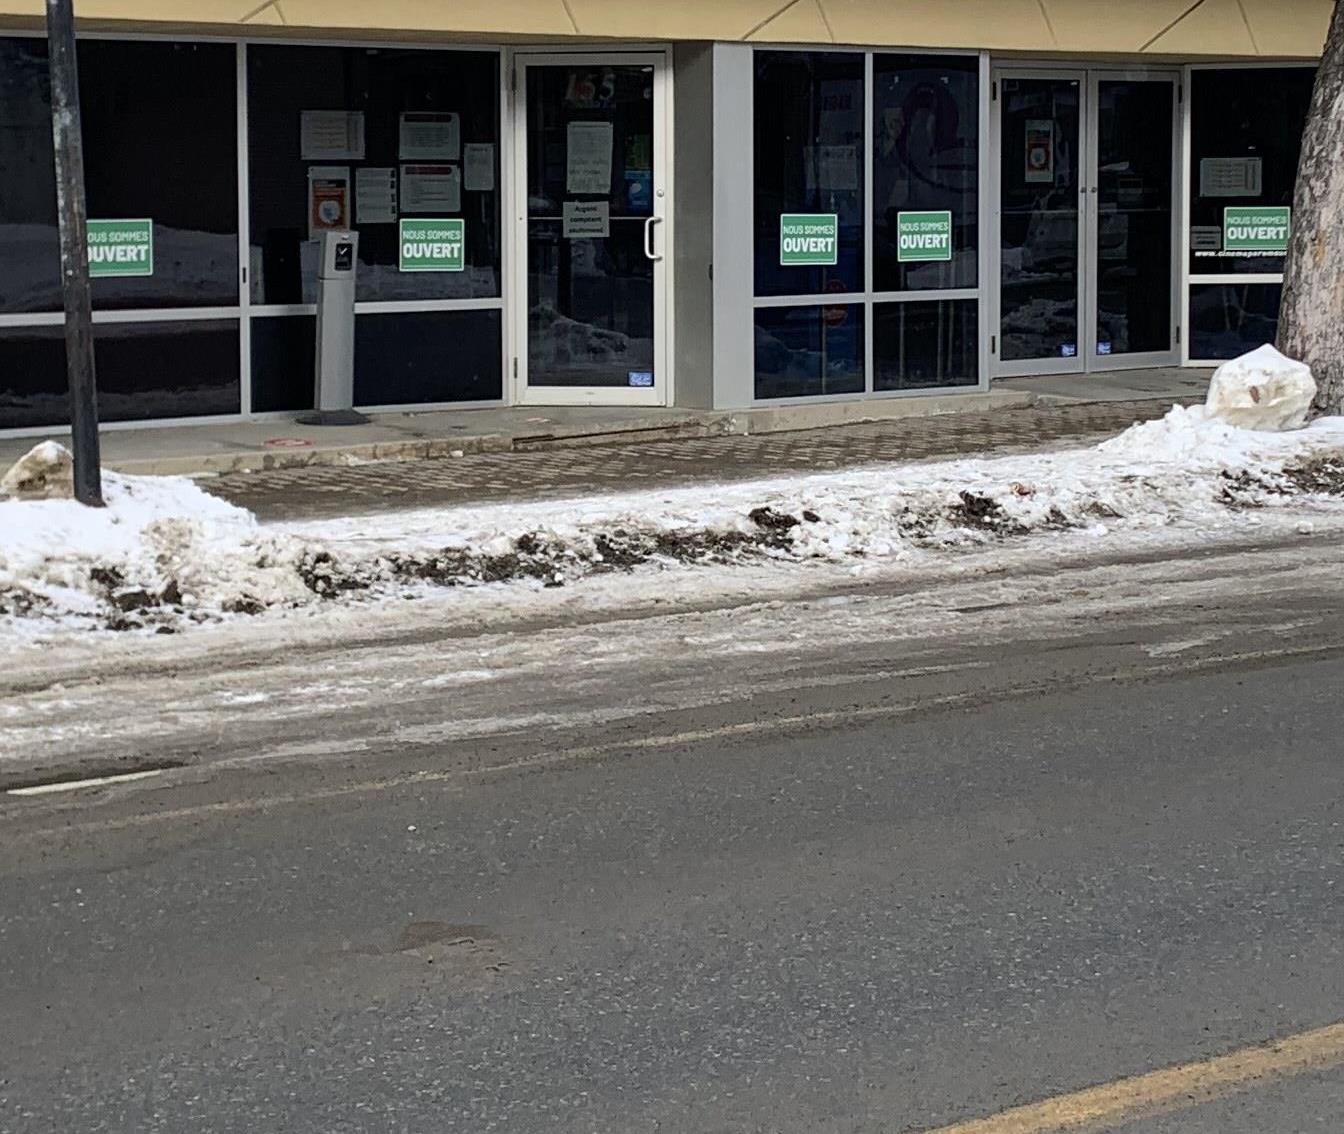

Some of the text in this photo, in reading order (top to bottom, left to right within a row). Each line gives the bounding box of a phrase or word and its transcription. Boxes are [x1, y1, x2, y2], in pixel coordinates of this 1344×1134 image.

[900, 221, 949, 232] NOUS SOMMES
[1227, 215, 1287, 225] NOUS SOMMES
[87, 230, 149, 243] OUS SOMMES
[402, 229, 461, 241] NOUS SOMMES
[783, 225, 834, 235] NOUS SOMMES
[1227, 226, 1287, 240] OUVERT
[783, 237, 834, 253] OUVERT
[900, 233, 949, 249] OUVERT
[402, 242, 461, 259] OUVERT
